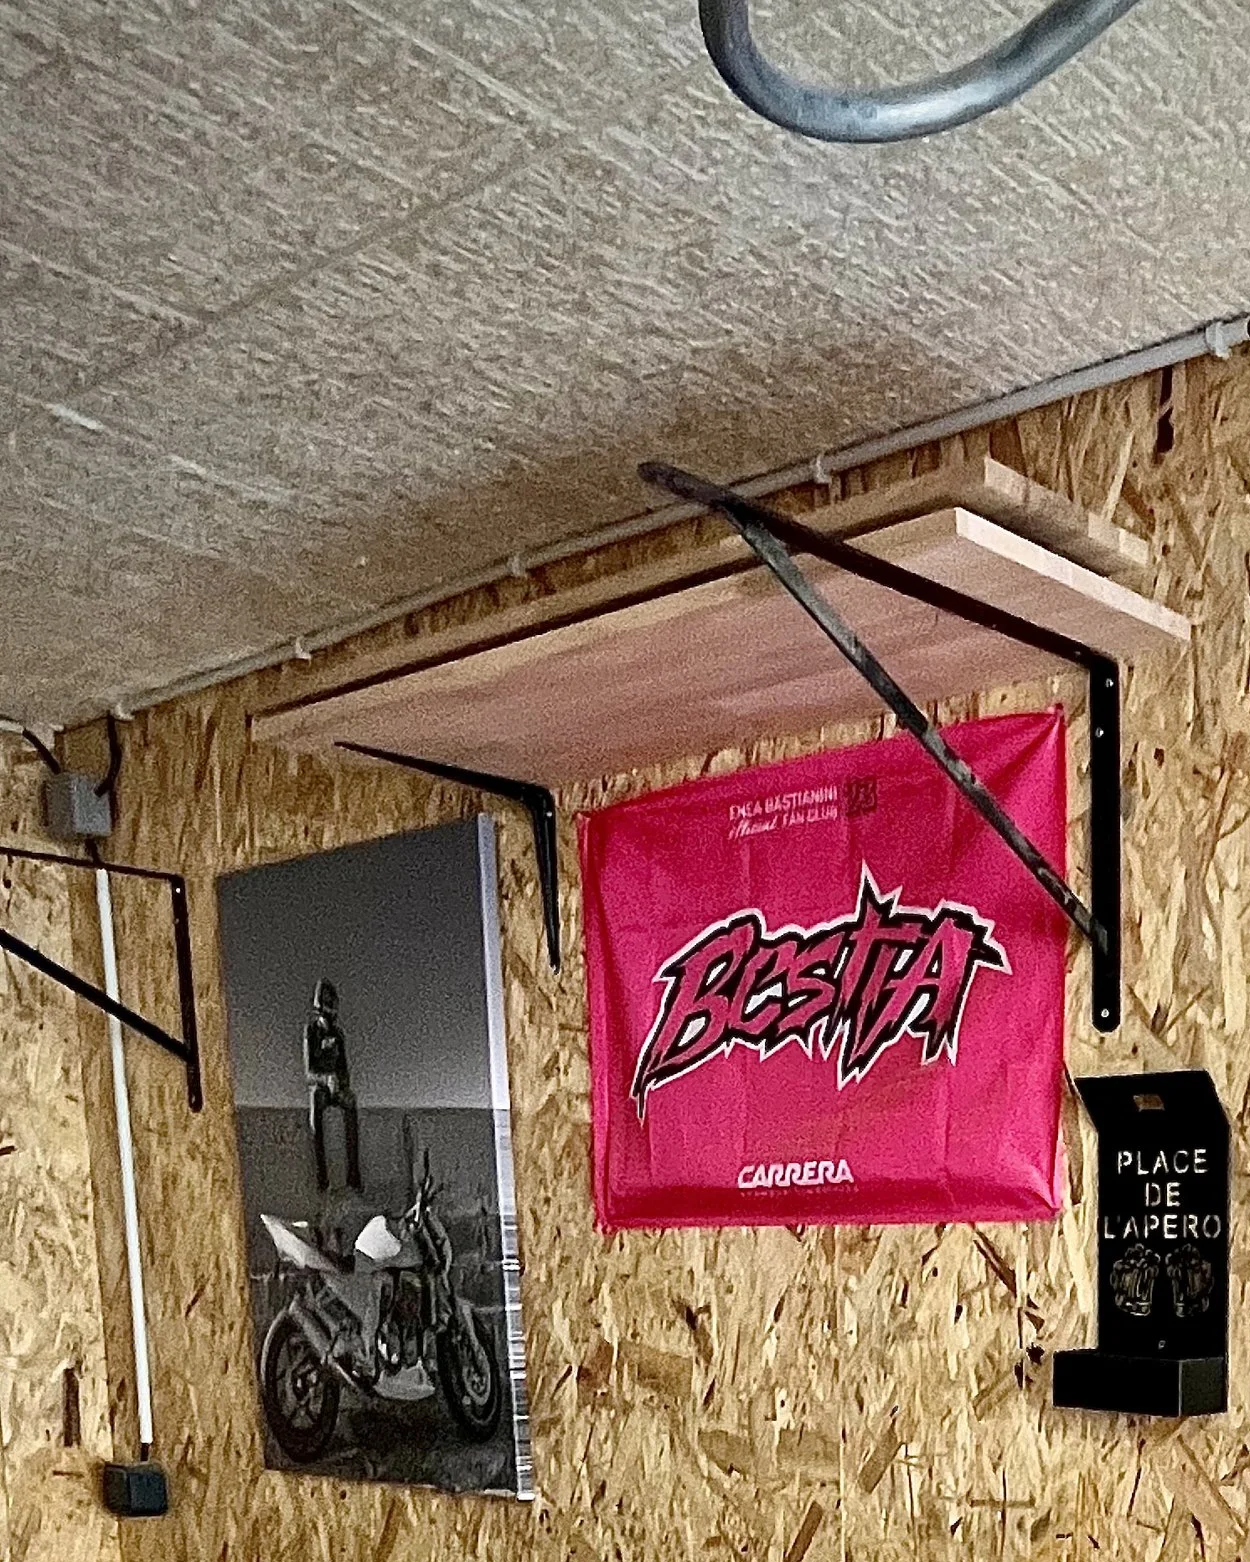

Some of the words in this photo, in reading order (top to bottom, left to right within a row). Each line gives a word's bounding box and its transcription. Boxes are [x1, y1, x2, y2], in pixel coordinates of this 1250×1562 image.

[737, 1159, 855, 1189] CARRERA
[1116, 1149, 1210, 1175] PLACE
[1144, 1182, 1182, 1208] DE
[1103, 1214, 1223, 1240] L'APERO
